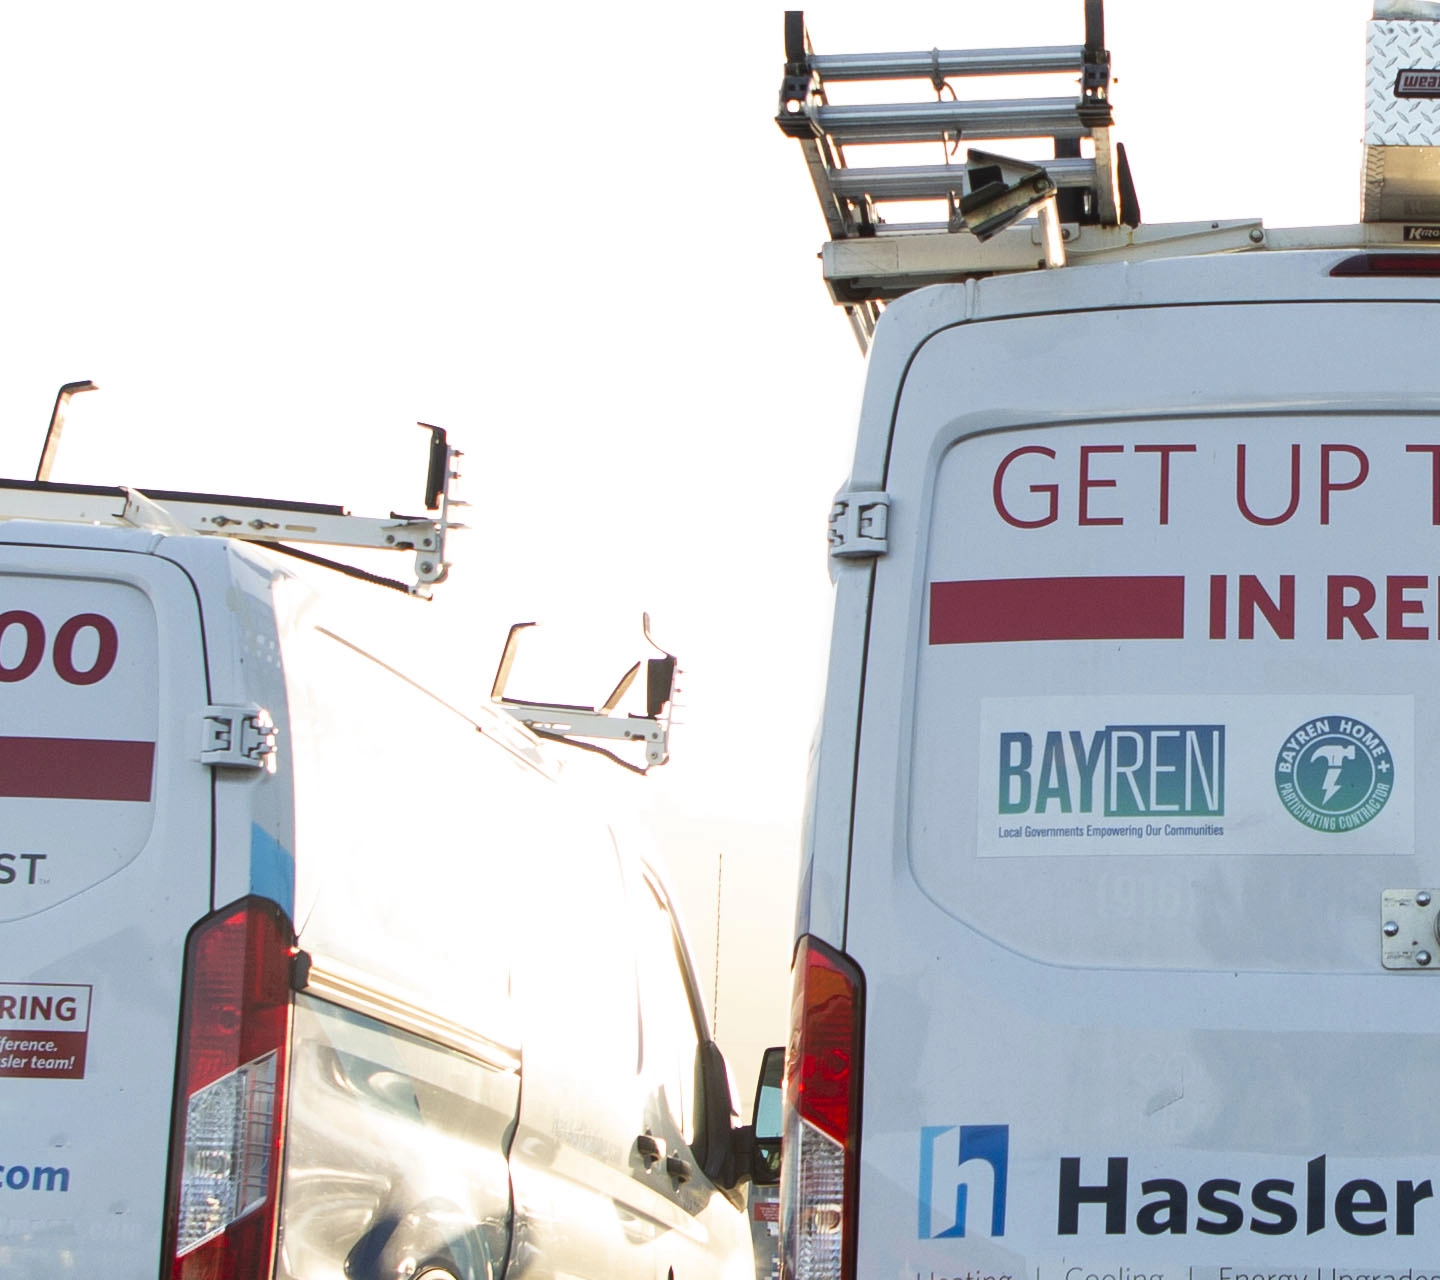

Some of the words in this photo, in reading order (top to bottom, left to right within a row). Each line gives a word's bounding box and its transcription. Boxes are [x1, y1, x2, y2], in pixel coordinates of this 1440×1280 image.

[992, 443, 1197, 529] GET
[1235, 443, 1370, 527] UP
[1209, 574, 1296, 640] IN
[998, 725, 1226, 817] BAYREN
[1279, 719, 1330, 774] BAYREN
[998, 825, 1023, 839] Local
[1025, 825, 1085, 838] Governments
[1086, 824, 1144, 840] Empowering
[1145, 824, 1162, 837] Our
[1164, 823, 1225, 838] Communities
[1279, 782, 1338, 831] PARTICIPATING
[1339, 782, 1391, 831] CONTRACTOR
[30, 1053, 76, 1071] team!
[1057, 1153, 1435, 1236] Hassler
